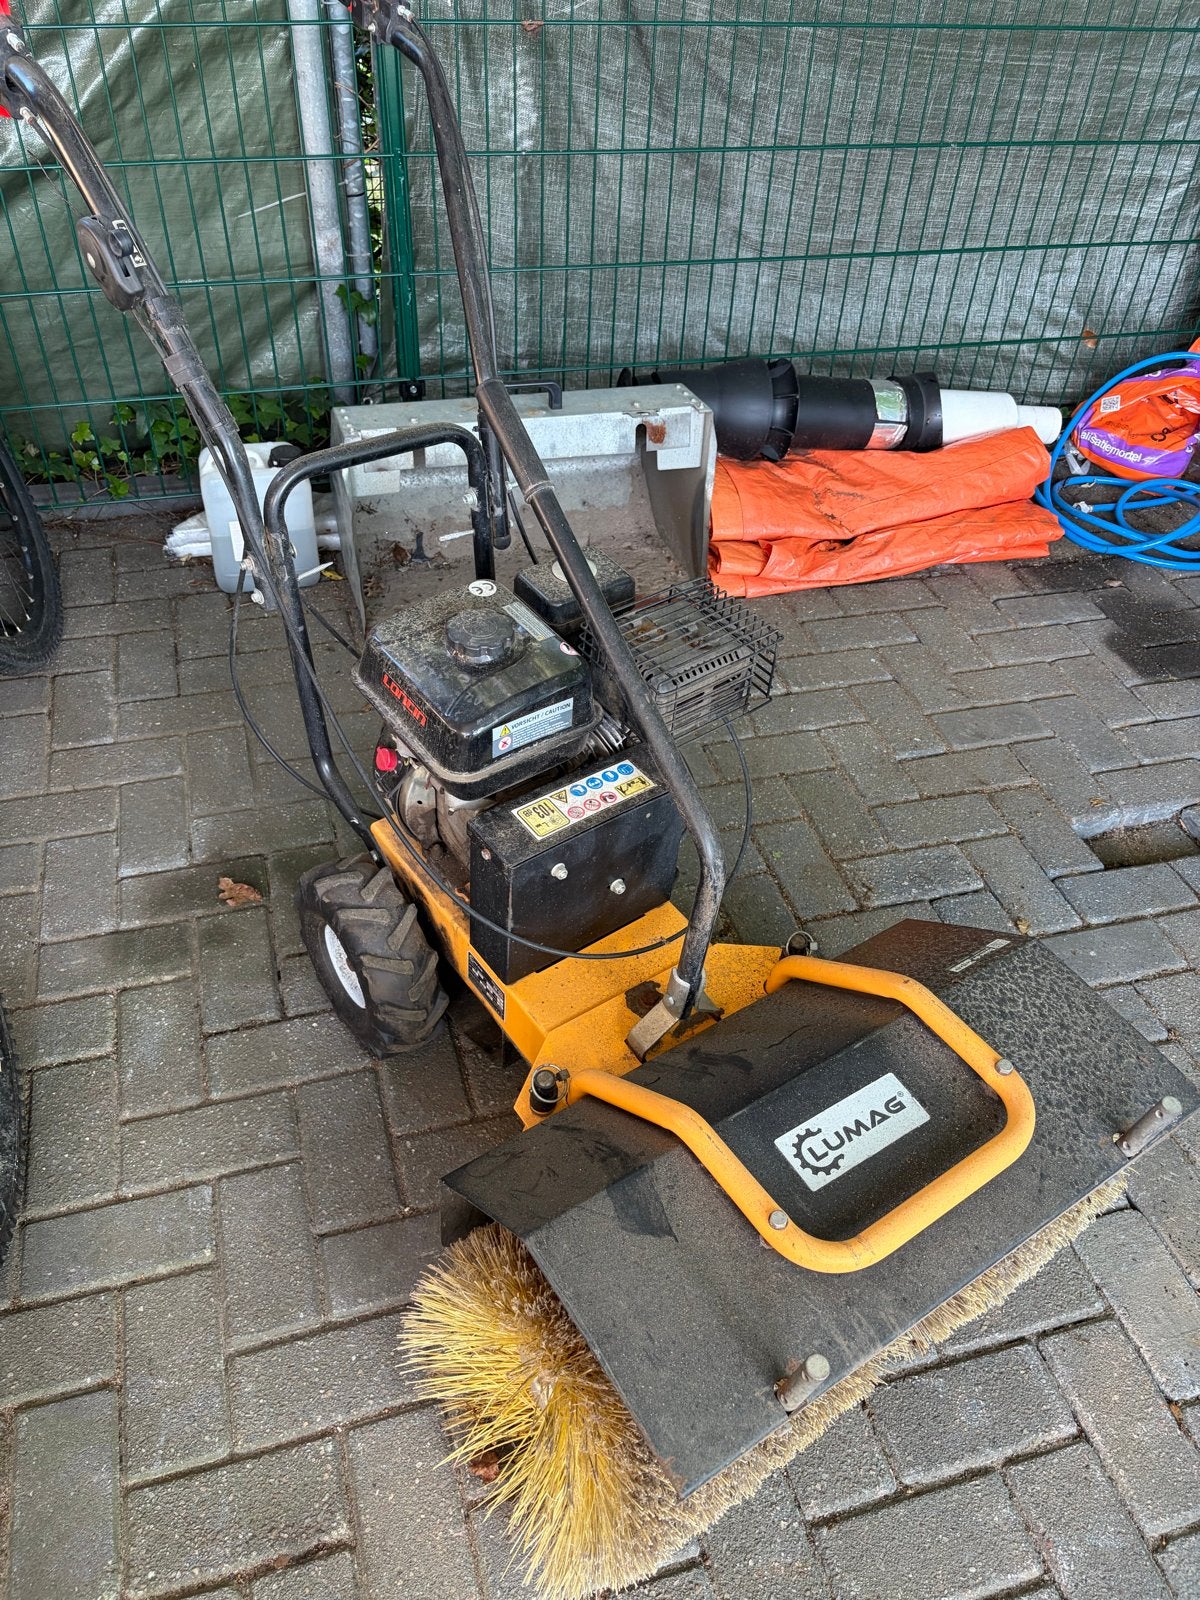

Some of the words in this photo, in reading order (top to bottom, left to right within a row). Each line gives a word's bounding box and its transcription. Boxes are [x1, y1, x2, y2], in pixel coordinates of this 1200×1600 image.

[511, 714, 540, 730] VORSICHT
[544, 702, 571, 716] CAUTION
[532, 802, 555, 819] 103
[807, 1095, 907, 1163] LUMAG
